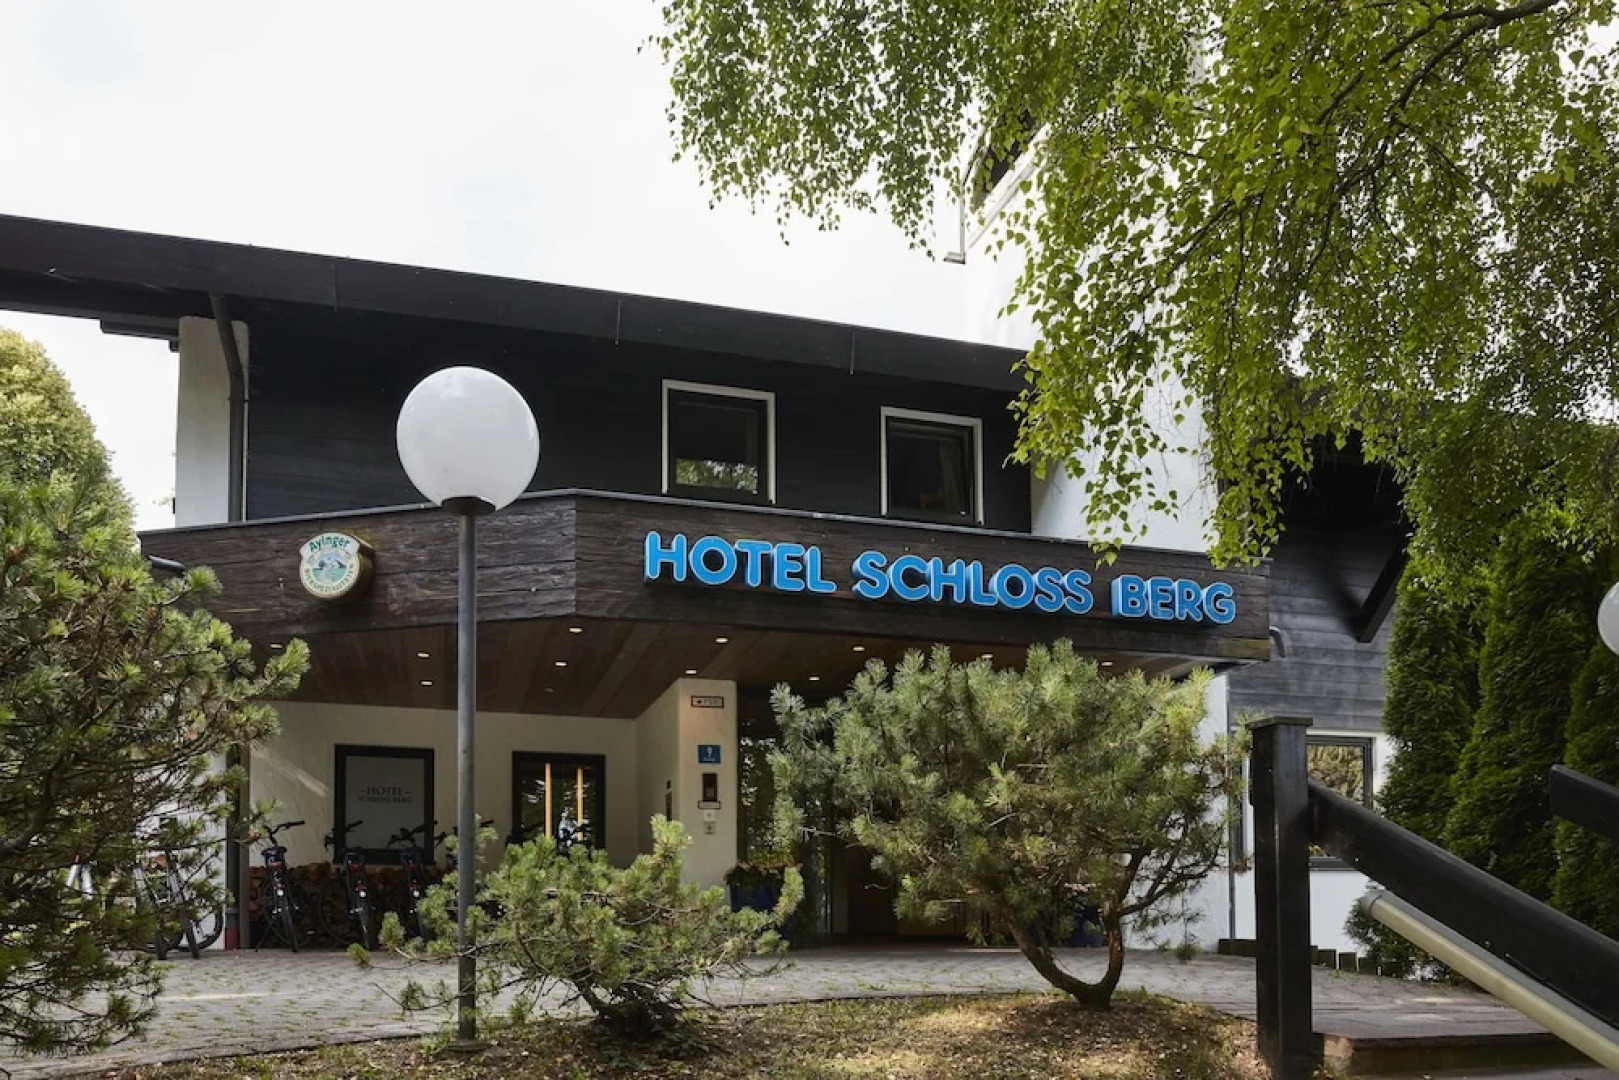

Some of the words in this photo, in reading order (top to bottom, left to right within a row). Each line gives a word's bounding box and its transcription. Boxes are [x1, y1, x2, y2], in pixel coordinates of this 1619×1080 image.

[645, 531, 837, 593] HOTEL
[852, 551, 1093, 614] SCHLOSS
[1111, 575, 1236, 624] BERG
